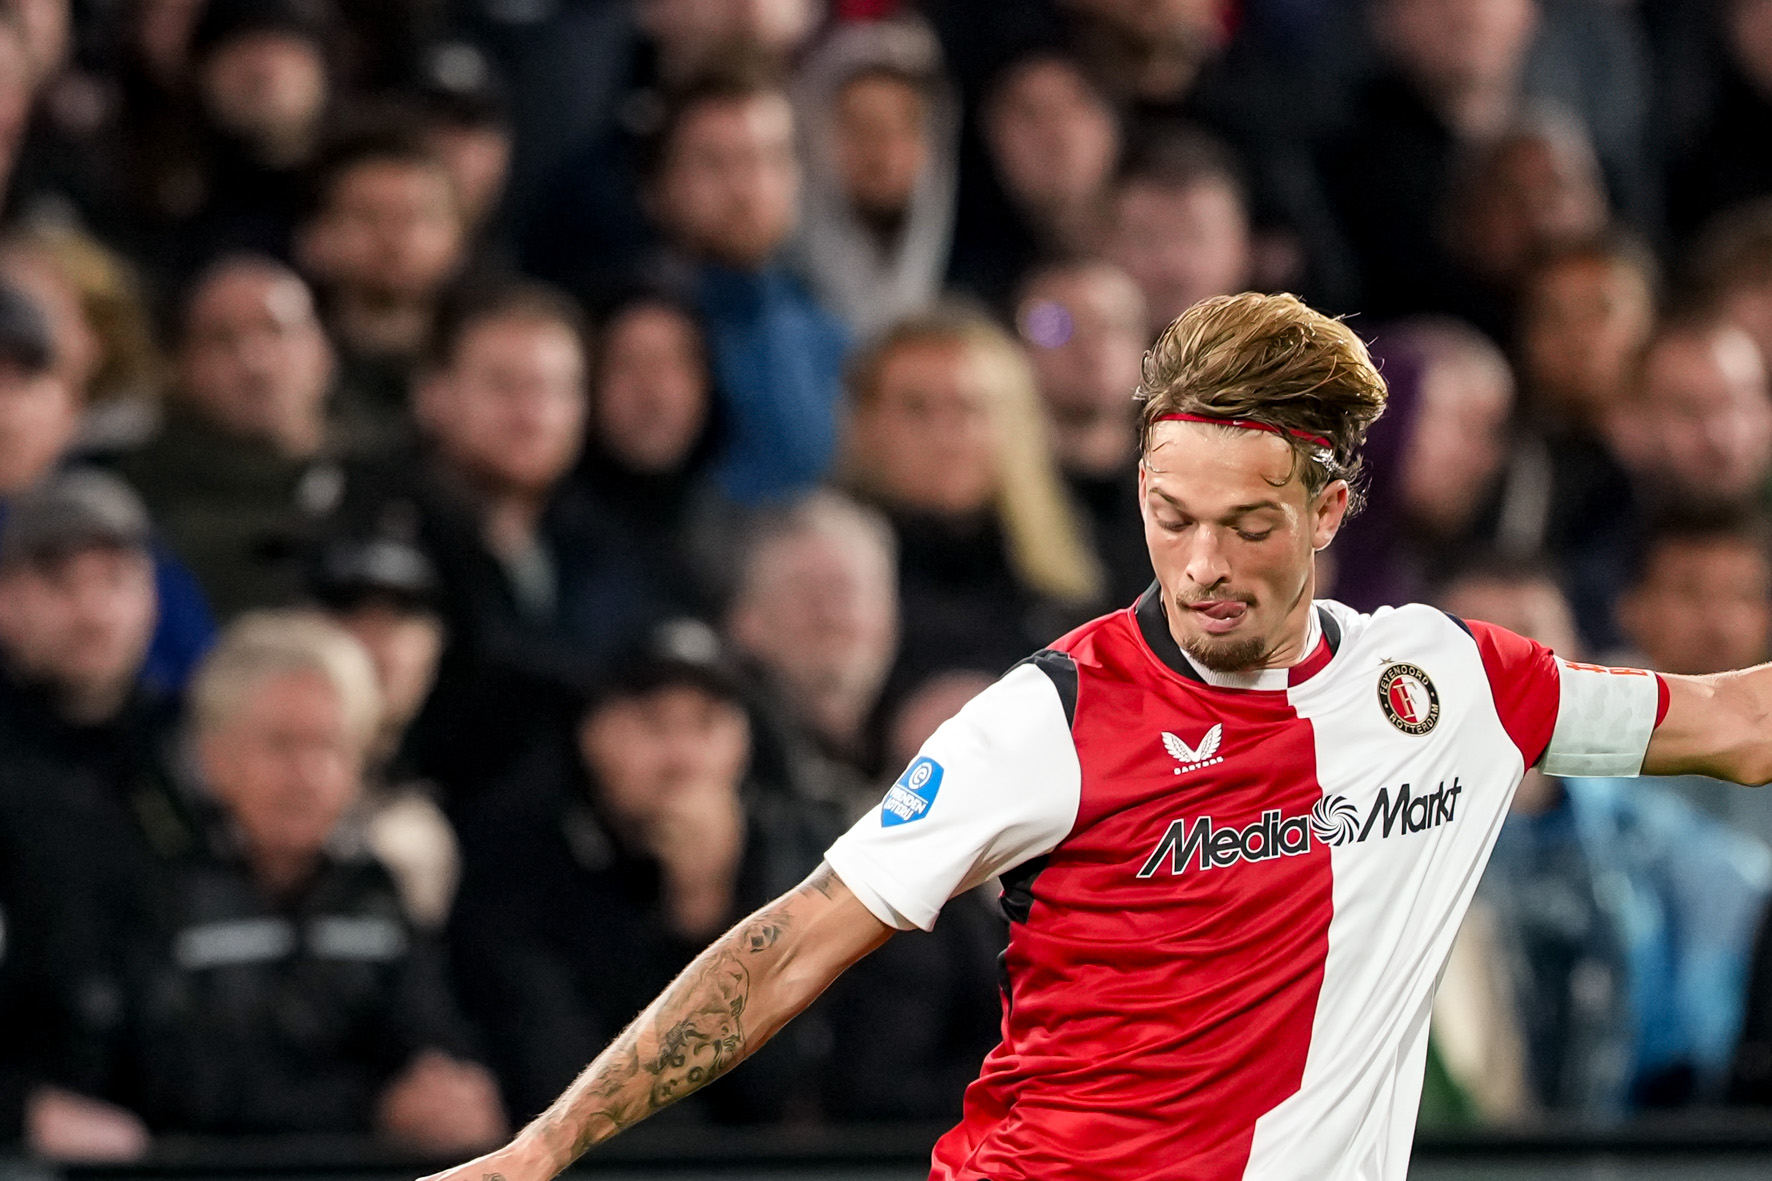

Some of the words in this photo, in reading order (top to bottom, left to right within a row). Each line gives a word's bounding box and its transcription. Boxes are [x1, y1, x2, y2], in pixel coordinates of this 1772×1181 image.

[1380, 665, 1429, 695] FEYENOORD
[1389, 703, 1439, 734] ROTTERDAM
[1136, 808, 1311, 879] Media
[1357, 777, 1462, 843] Markt
